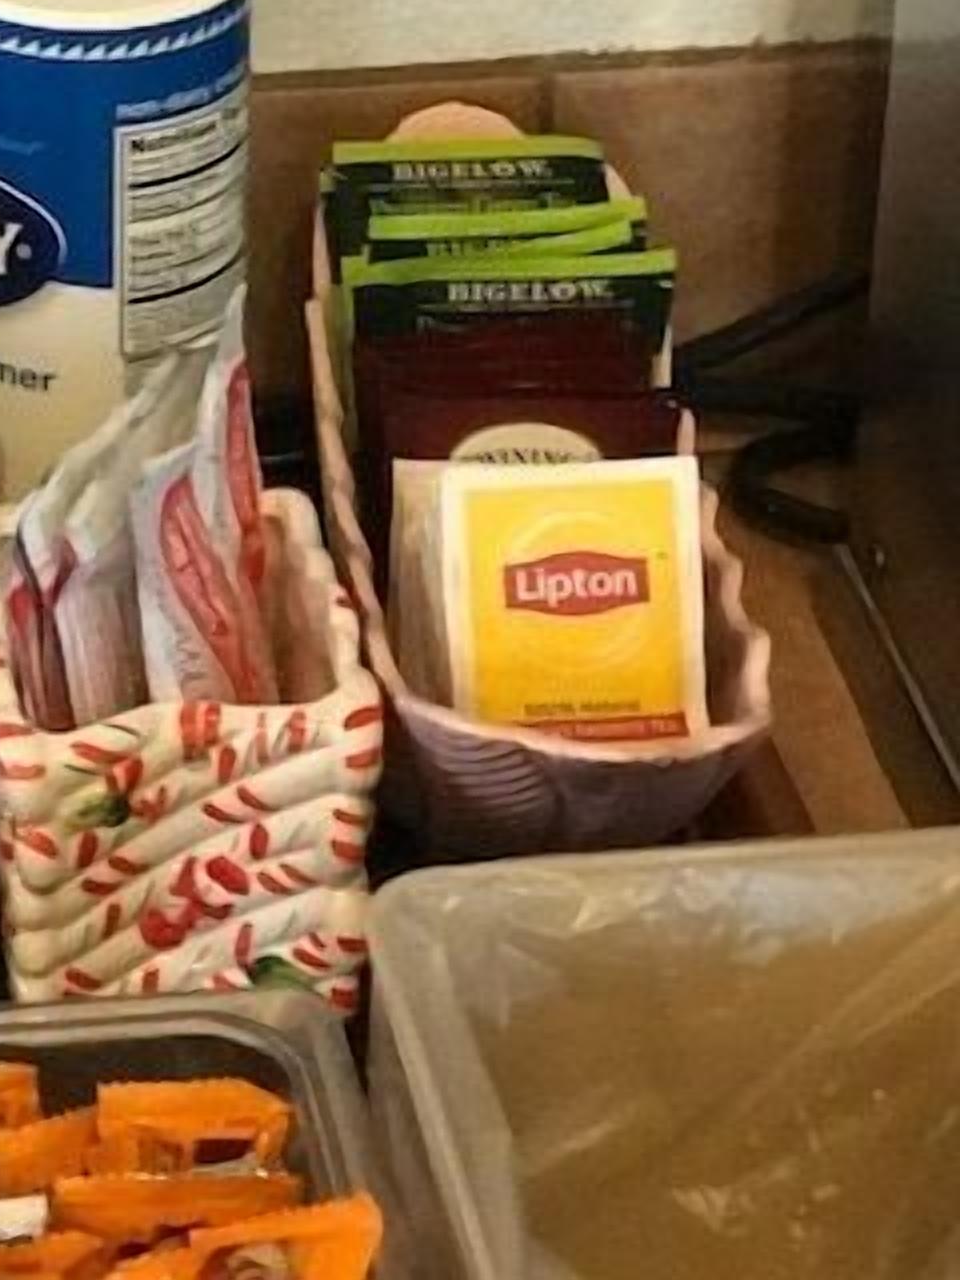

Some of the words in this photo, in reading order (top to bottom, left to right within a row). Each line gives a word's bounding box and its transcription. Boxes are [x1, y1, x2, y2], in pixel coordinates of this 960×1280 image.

[392, 159, 553, 182] BIGELOW
[447, 279, 616, 302] BIGELOW
[515, 567, 639, 609] Lipton
